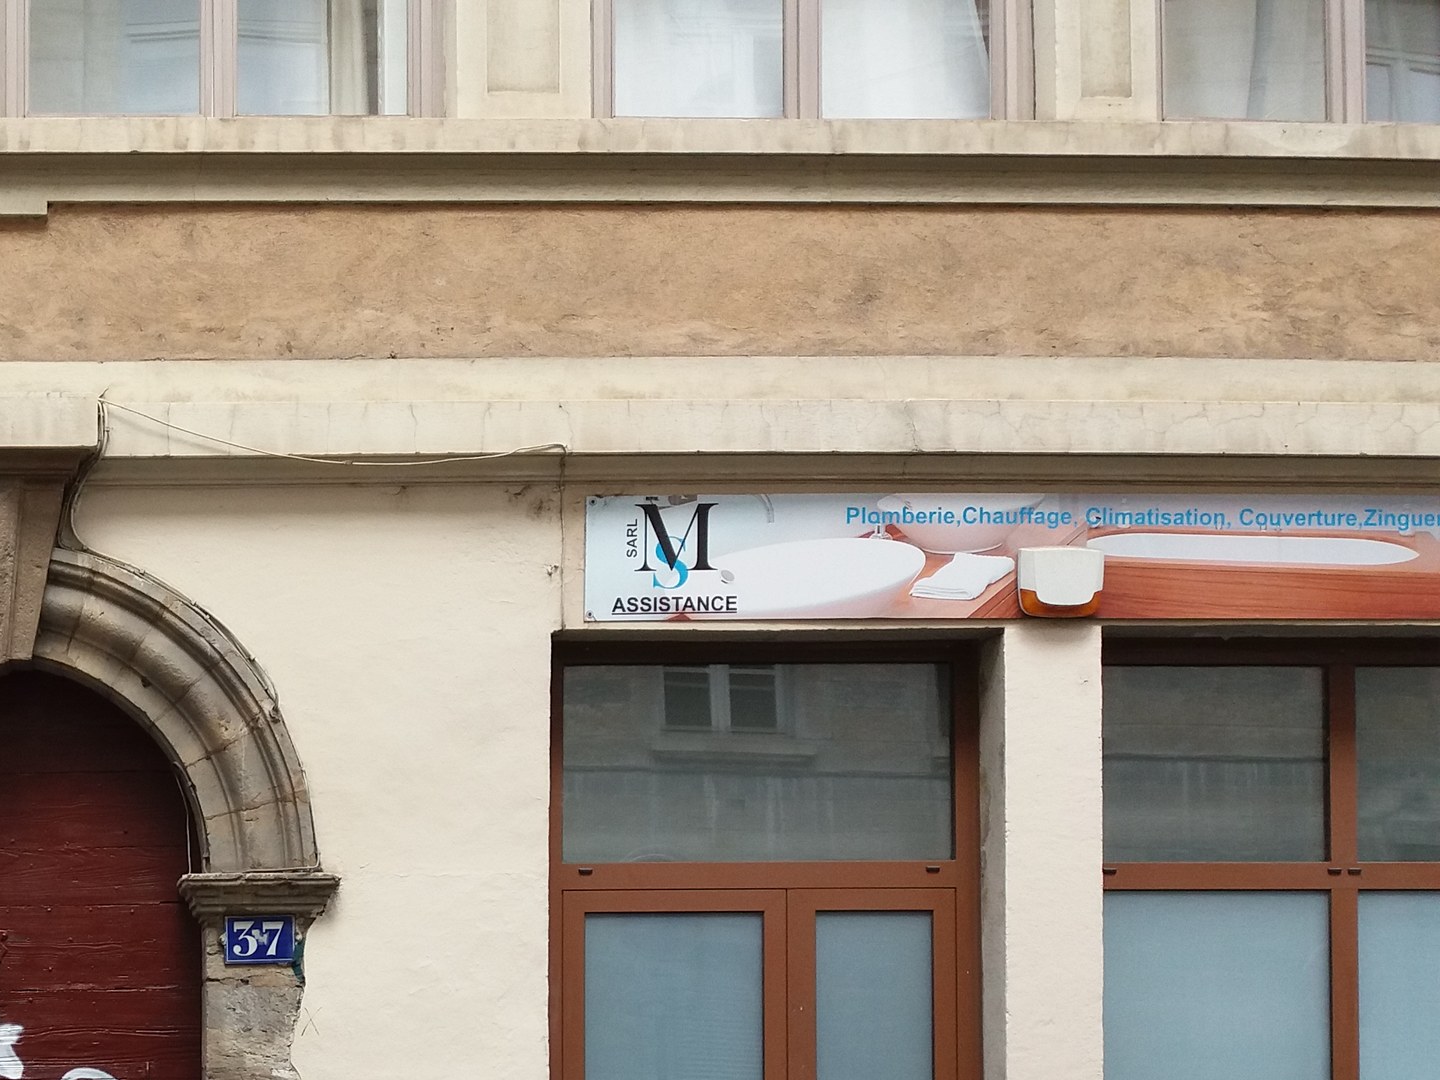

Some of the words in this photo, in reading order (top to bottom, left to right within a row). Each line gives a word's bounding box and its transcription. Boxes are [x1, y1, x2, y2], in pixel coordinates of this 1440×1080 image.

[626, 518, 638, 558] SARL
[611, 595, 738, 613] ASSISTANCE
[232, 921, 284, 957] 37
